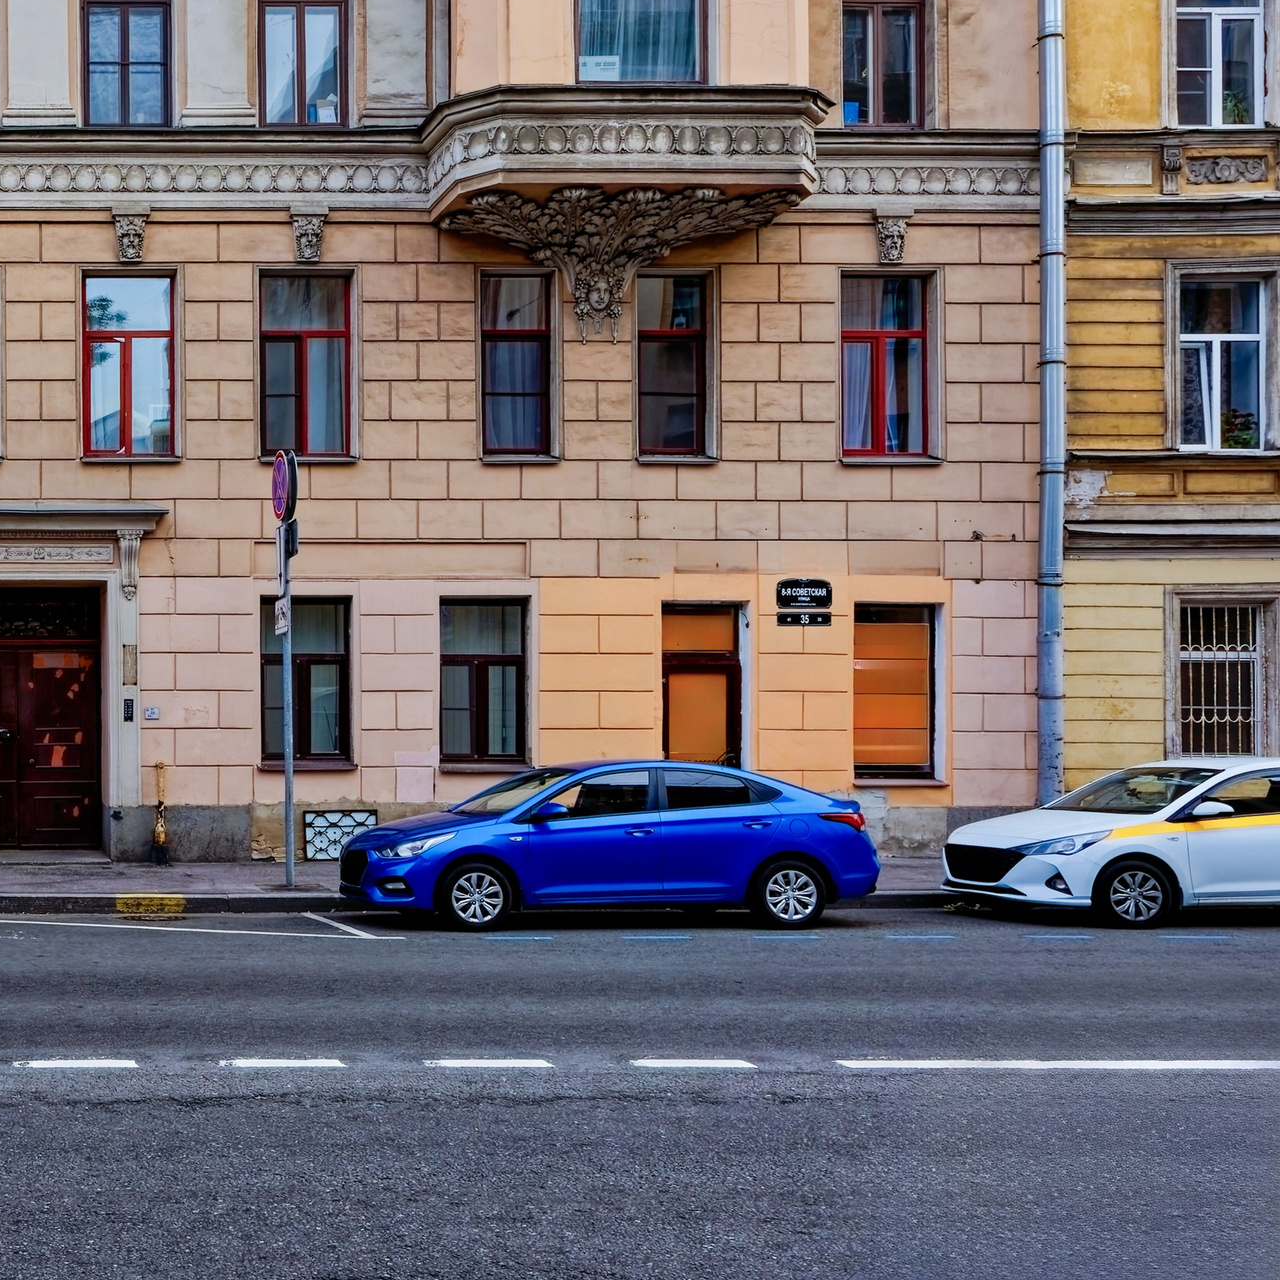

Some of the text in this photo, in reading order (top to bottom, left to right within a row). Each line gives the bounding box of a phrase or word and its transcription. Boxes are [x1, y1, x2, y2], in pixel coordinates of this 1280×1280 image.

[781, 588, 827, 596] 8-Я СОВЕТСКАЯ
[800, 614, 810, 624] 35
